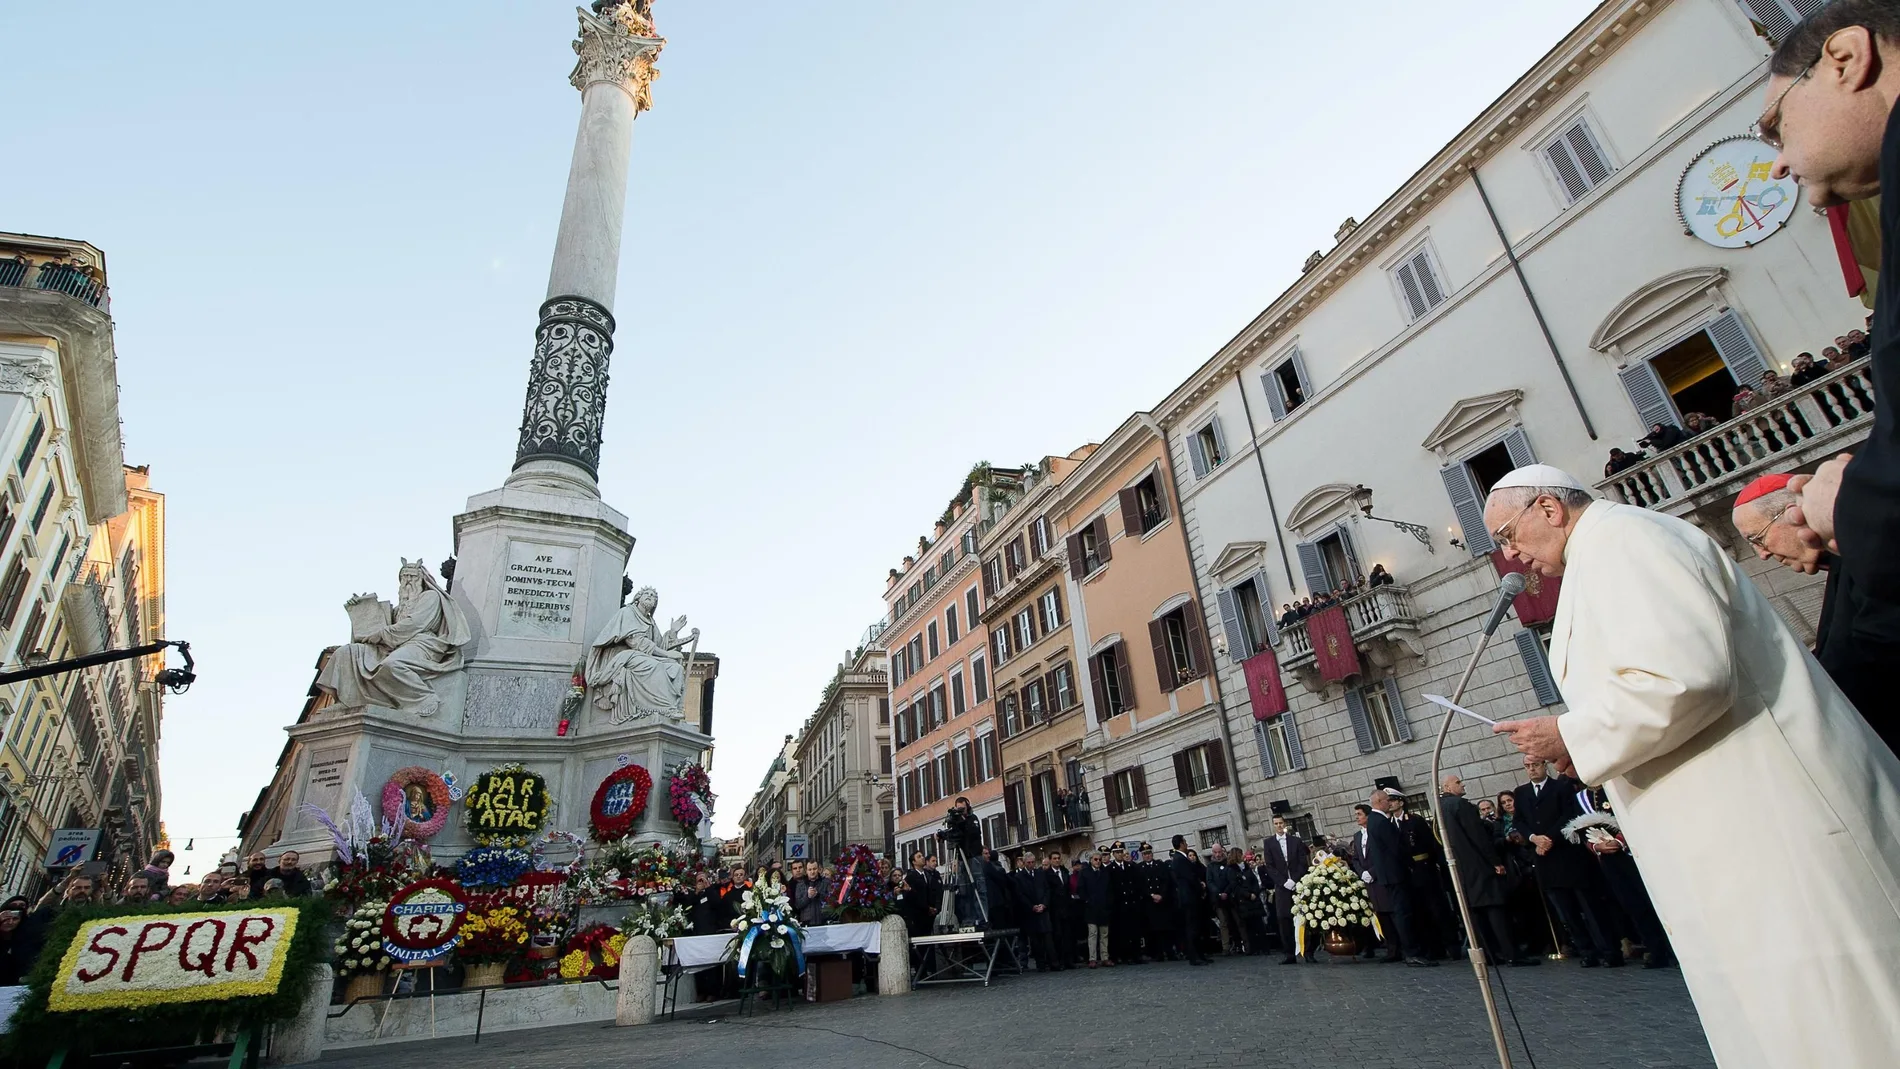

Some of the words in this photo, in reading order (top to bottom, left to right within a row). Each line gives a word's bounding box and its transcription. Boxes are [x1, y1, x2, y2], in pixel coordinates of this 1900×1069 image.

[535, 555, 553, 563] AVE
[480, 808, 538, 829] ATAC
[393, 904, 464, 914] CHARITAS
[77, 916, 276, 983] SPQR
